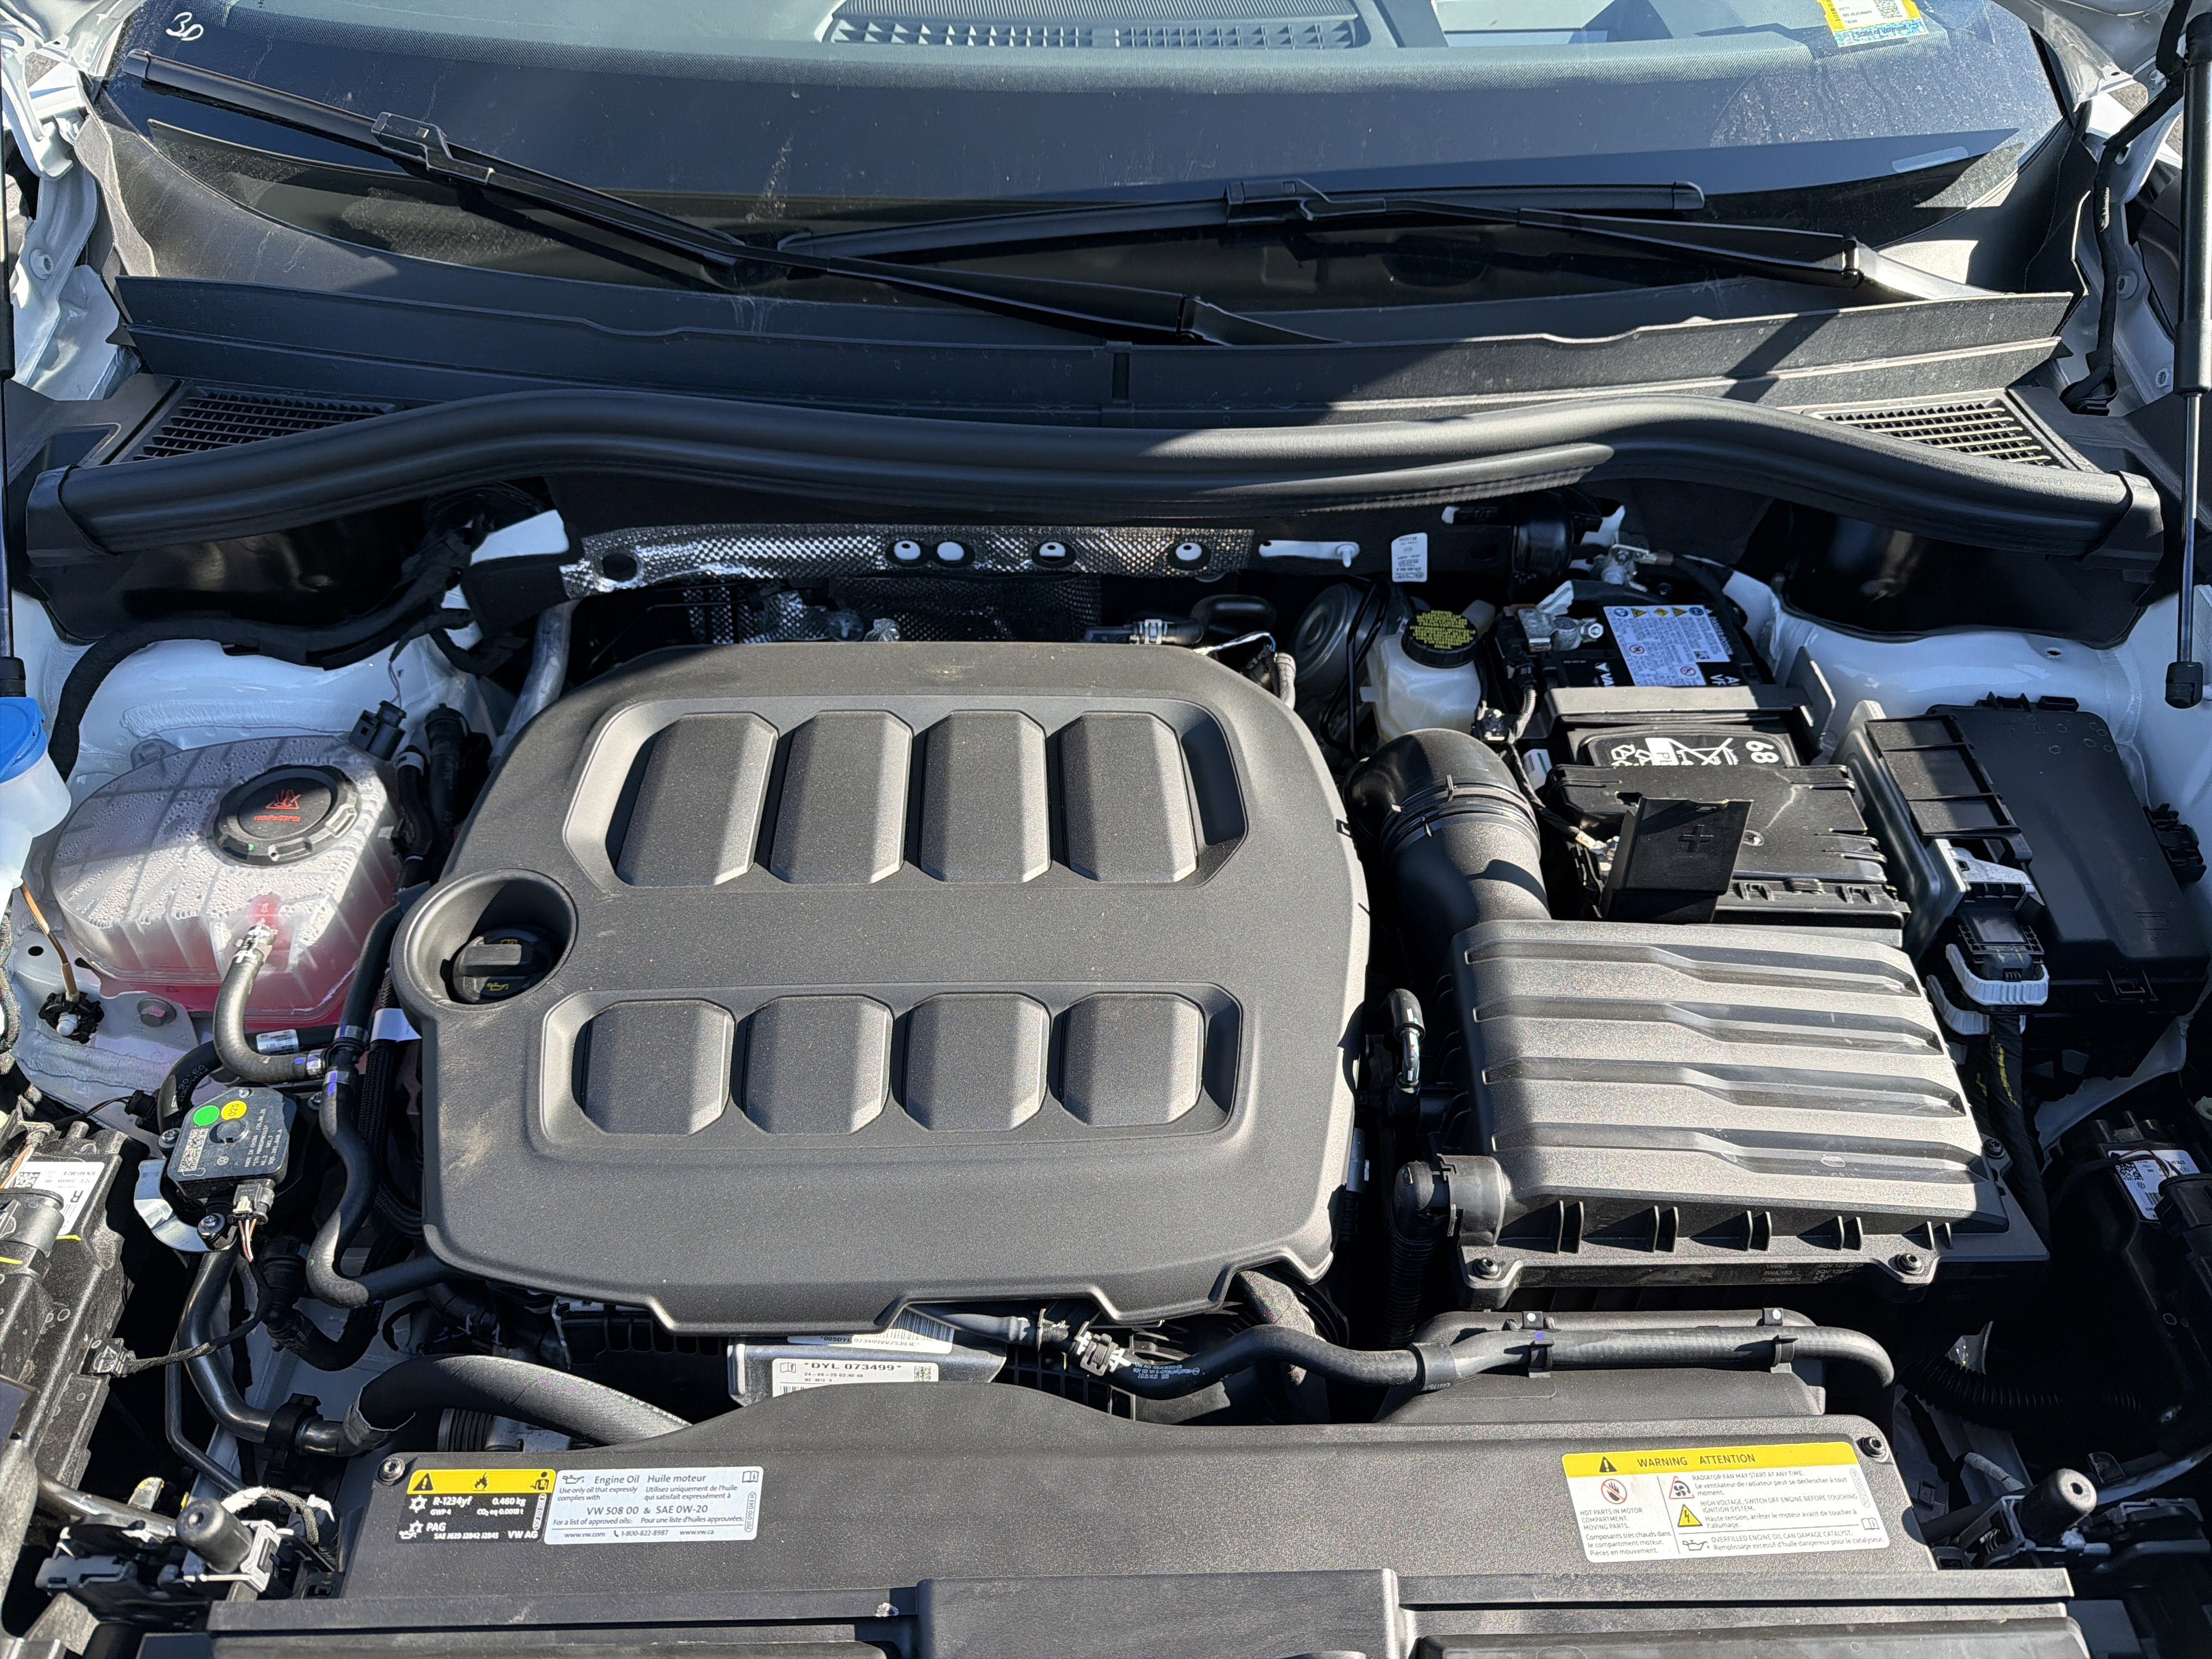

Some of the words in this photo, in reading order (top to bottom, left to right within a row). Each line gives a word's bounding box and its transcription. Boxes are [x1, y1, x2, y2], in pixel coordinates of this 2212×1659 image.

[1881, 26, 1907, 35] Vermont
[250, 1135, 258, 1148] CHINA
[70, 1190, 84, 1203] R
[1637, 1456, 1688, 1468] WARNING
[1700, 1452, 1757, 1465] ATTENTION
[594, 1475, 625, 1486] Engine
[627, 1475, 640, 1483] Oil
[647, 1474, 671, 1483] Huile
[673, 1474, 707, 1482] moteur
[608, 1486, 638, 1494] expressly
[670, 1485, 708, 1493] uniquement
[432, 1496, 473, 1508] R-1234yf
[492, 1497, 515, 1505] 0.460
[516, 1497, 527, 1507] kg
[644, 1493, 655, 1502] qui
[681, 1492, 726, 1501] expressément
[586, 1506, 604, 1515] VW
[605, 1506, 624, 1515] 508
[626, 1505, 639, 1515] 00
[656, 1505, 674, 1514] SAE
[675, 1504, 709, 1514] 0W-20
[588, 1517, 618, 1526] approved
[707, 1515, 744, 1524] approuvées:
[426, 1522, 447, 1532] PAG
[507, 1530, 524, 1538] VW
[524, 1530, 539, 1539] AG
[1711, 1534, 1747, 1543] OVERFILLED
